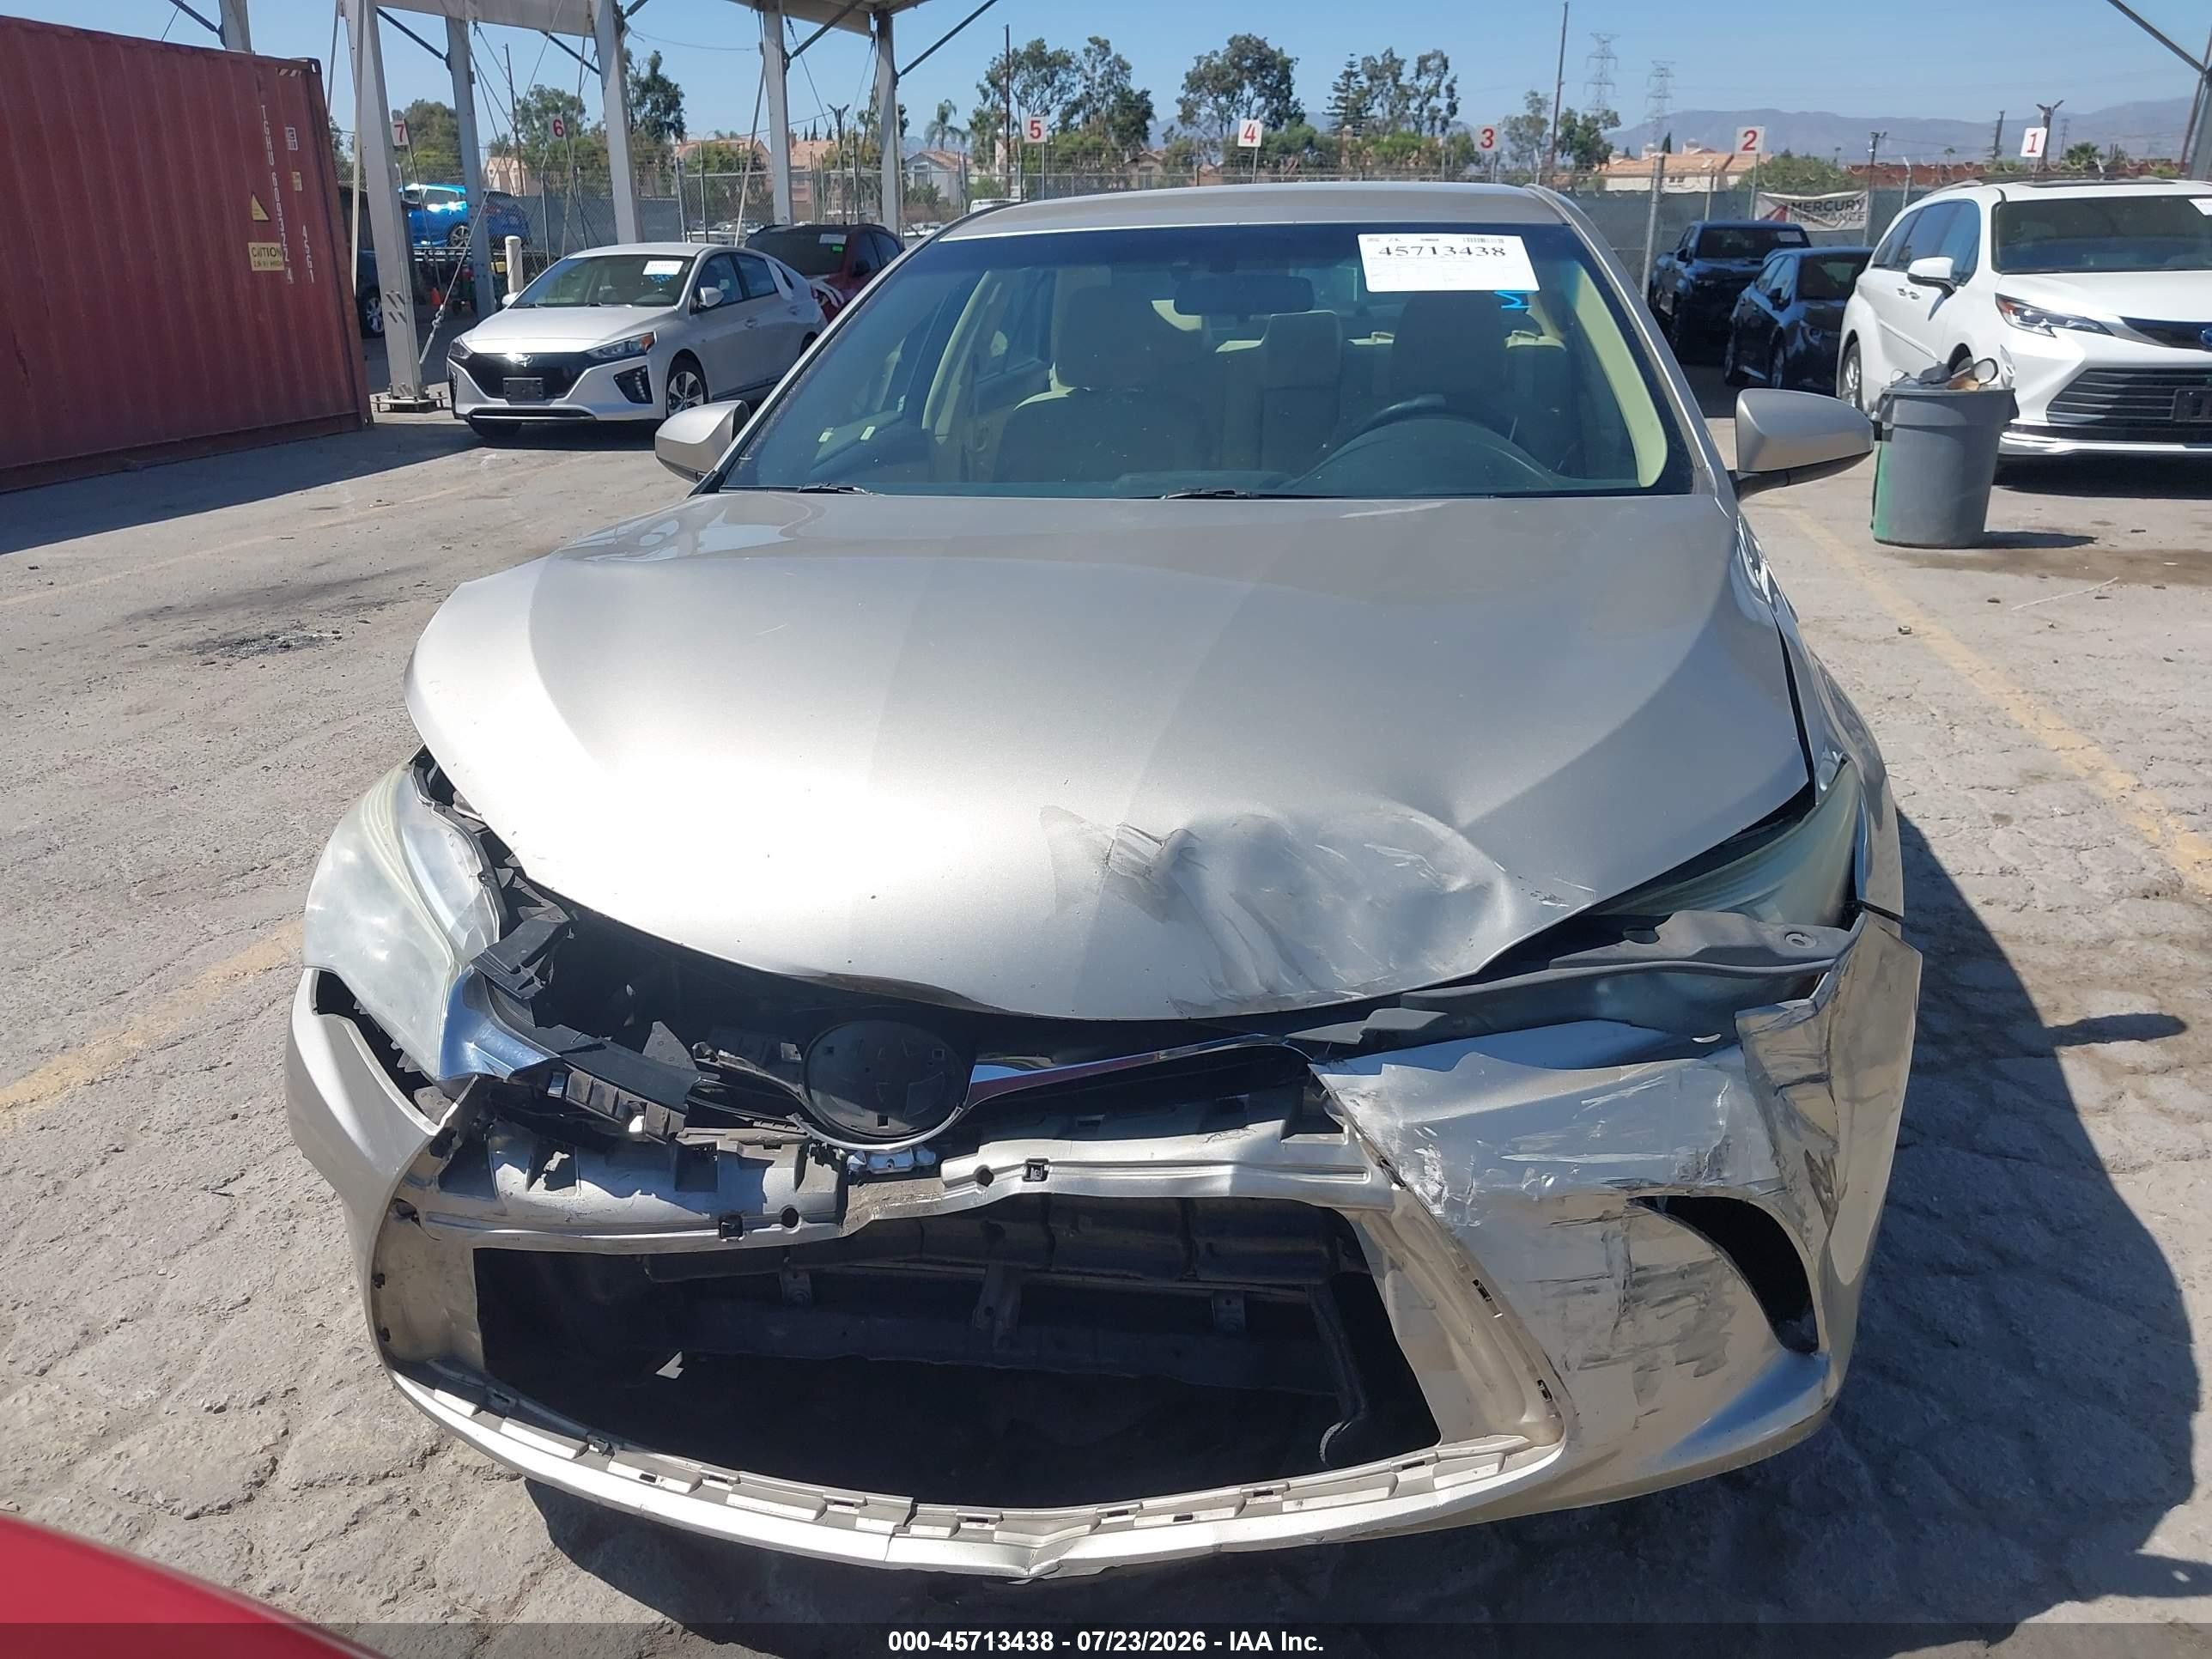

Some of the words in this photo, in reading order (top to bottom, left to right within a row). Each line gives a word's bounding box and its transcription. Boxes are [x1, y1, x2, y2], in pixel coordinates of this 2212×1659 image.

[261, 105, 275, 166] TGHU
[394, 124, 404, 143] 7
[552, 118, 565, 137] 6
[1030, 120, 1042, 139] 5
[1243, 123, 1256, 143] 4
[1480, 128, 1494, 149] 3
[1741, 130, 1758, 151] 2
[2027, 131, 2038, 153] 1
[1791, 198, 1866, 212] MERCURY
[1790, 210, 1865, 222] NSRANCE
[1378, 246, 1506, 257] 45713438
